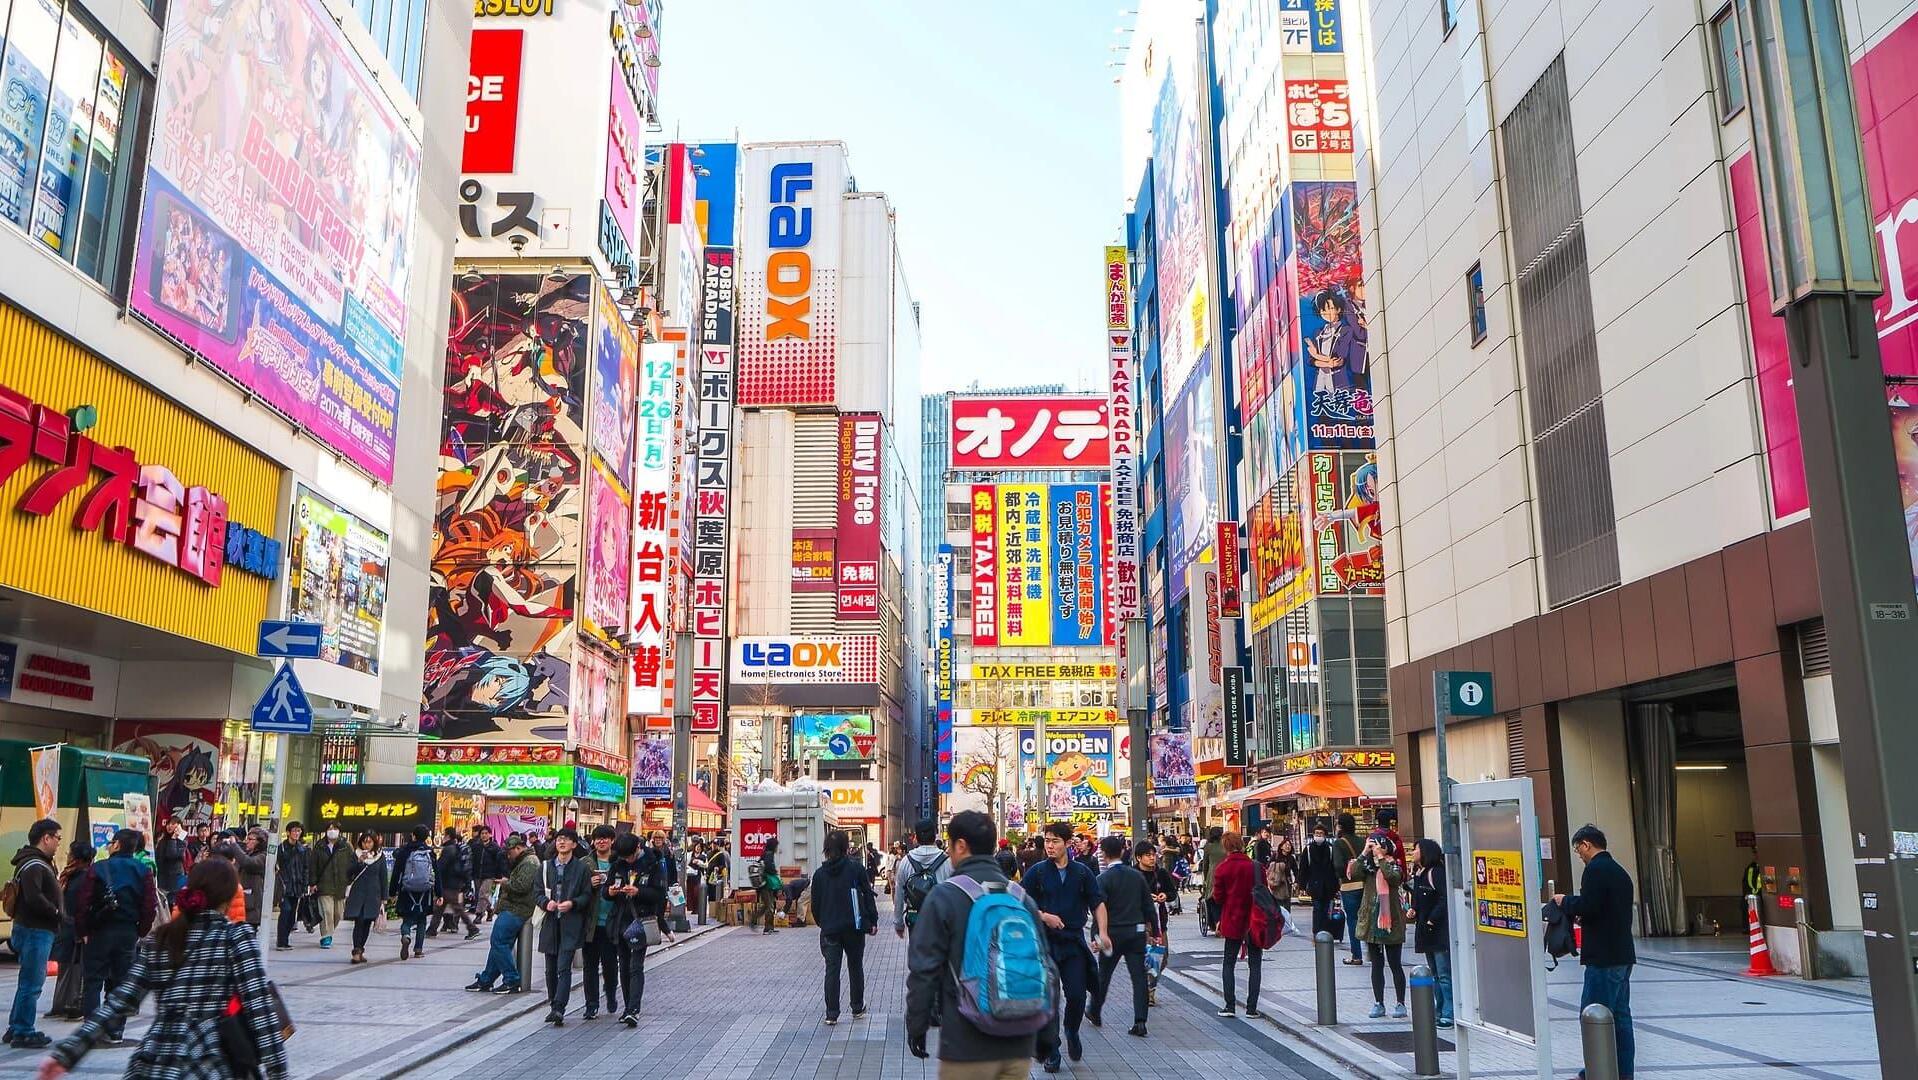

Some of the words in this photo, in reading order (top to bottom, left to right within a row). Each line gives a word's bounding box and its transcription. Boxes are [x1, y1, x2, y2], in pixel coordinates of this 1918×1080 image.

[1283, 17, 1308, 26] 当ビル
[1283, 29, 1308, 45] 7F
[1294, 134, 1315, 147] 6F
[704, 252, 718, 341] PARADISE
[718, 252, 733, 313] HOBBY
[1108, 262, 1126, 324] まんが喫茶
[640, 361, 672, 470] 12月26日(月)
[1112, 358, 1131, 453] TAKARADA
[840, 421, 854, 466] Flagship
[853, 421, 879, 471] Duty
[843, 469, 853, 501] Store
[854, 476, 878, 525] Free
[973, 491, 993, 533] 免税
[1025, 491, 1041, 543] 冷蔵庫
[1116, 508, 1134, 556] 免税商店
[793, 540, 813, 551] 本店
[974, 538, 993, 577] TAX
[1058, 502, 1074, 618] お見積り無料です
[632, 490, 667, 688] 新台入替
[842, 565, 875, 581] 免税
[938, 553, 951, 629] Panasonic
[1026, 548, 1042, 600] 洗濯機
[975, 583, 994, 637] FREE
[1205, 571, 1222, 686] GAMERS
[741, 669, 766, 678] Home
[769, 669, 816, 678] Electronics
[818, 669, 842, 678] Store
[939, 638, 951, 700] ONODEN
[980, 666, 1011, 678] TAX
[1015, 666, 1056, 678] FREE
[1059, 665, 1095, 678] 免税店
[981, 711, 1012, 722] テレビ
[1057, 712, 1101, 722] エアコン
[508, 774, 559, 789] 256ver
